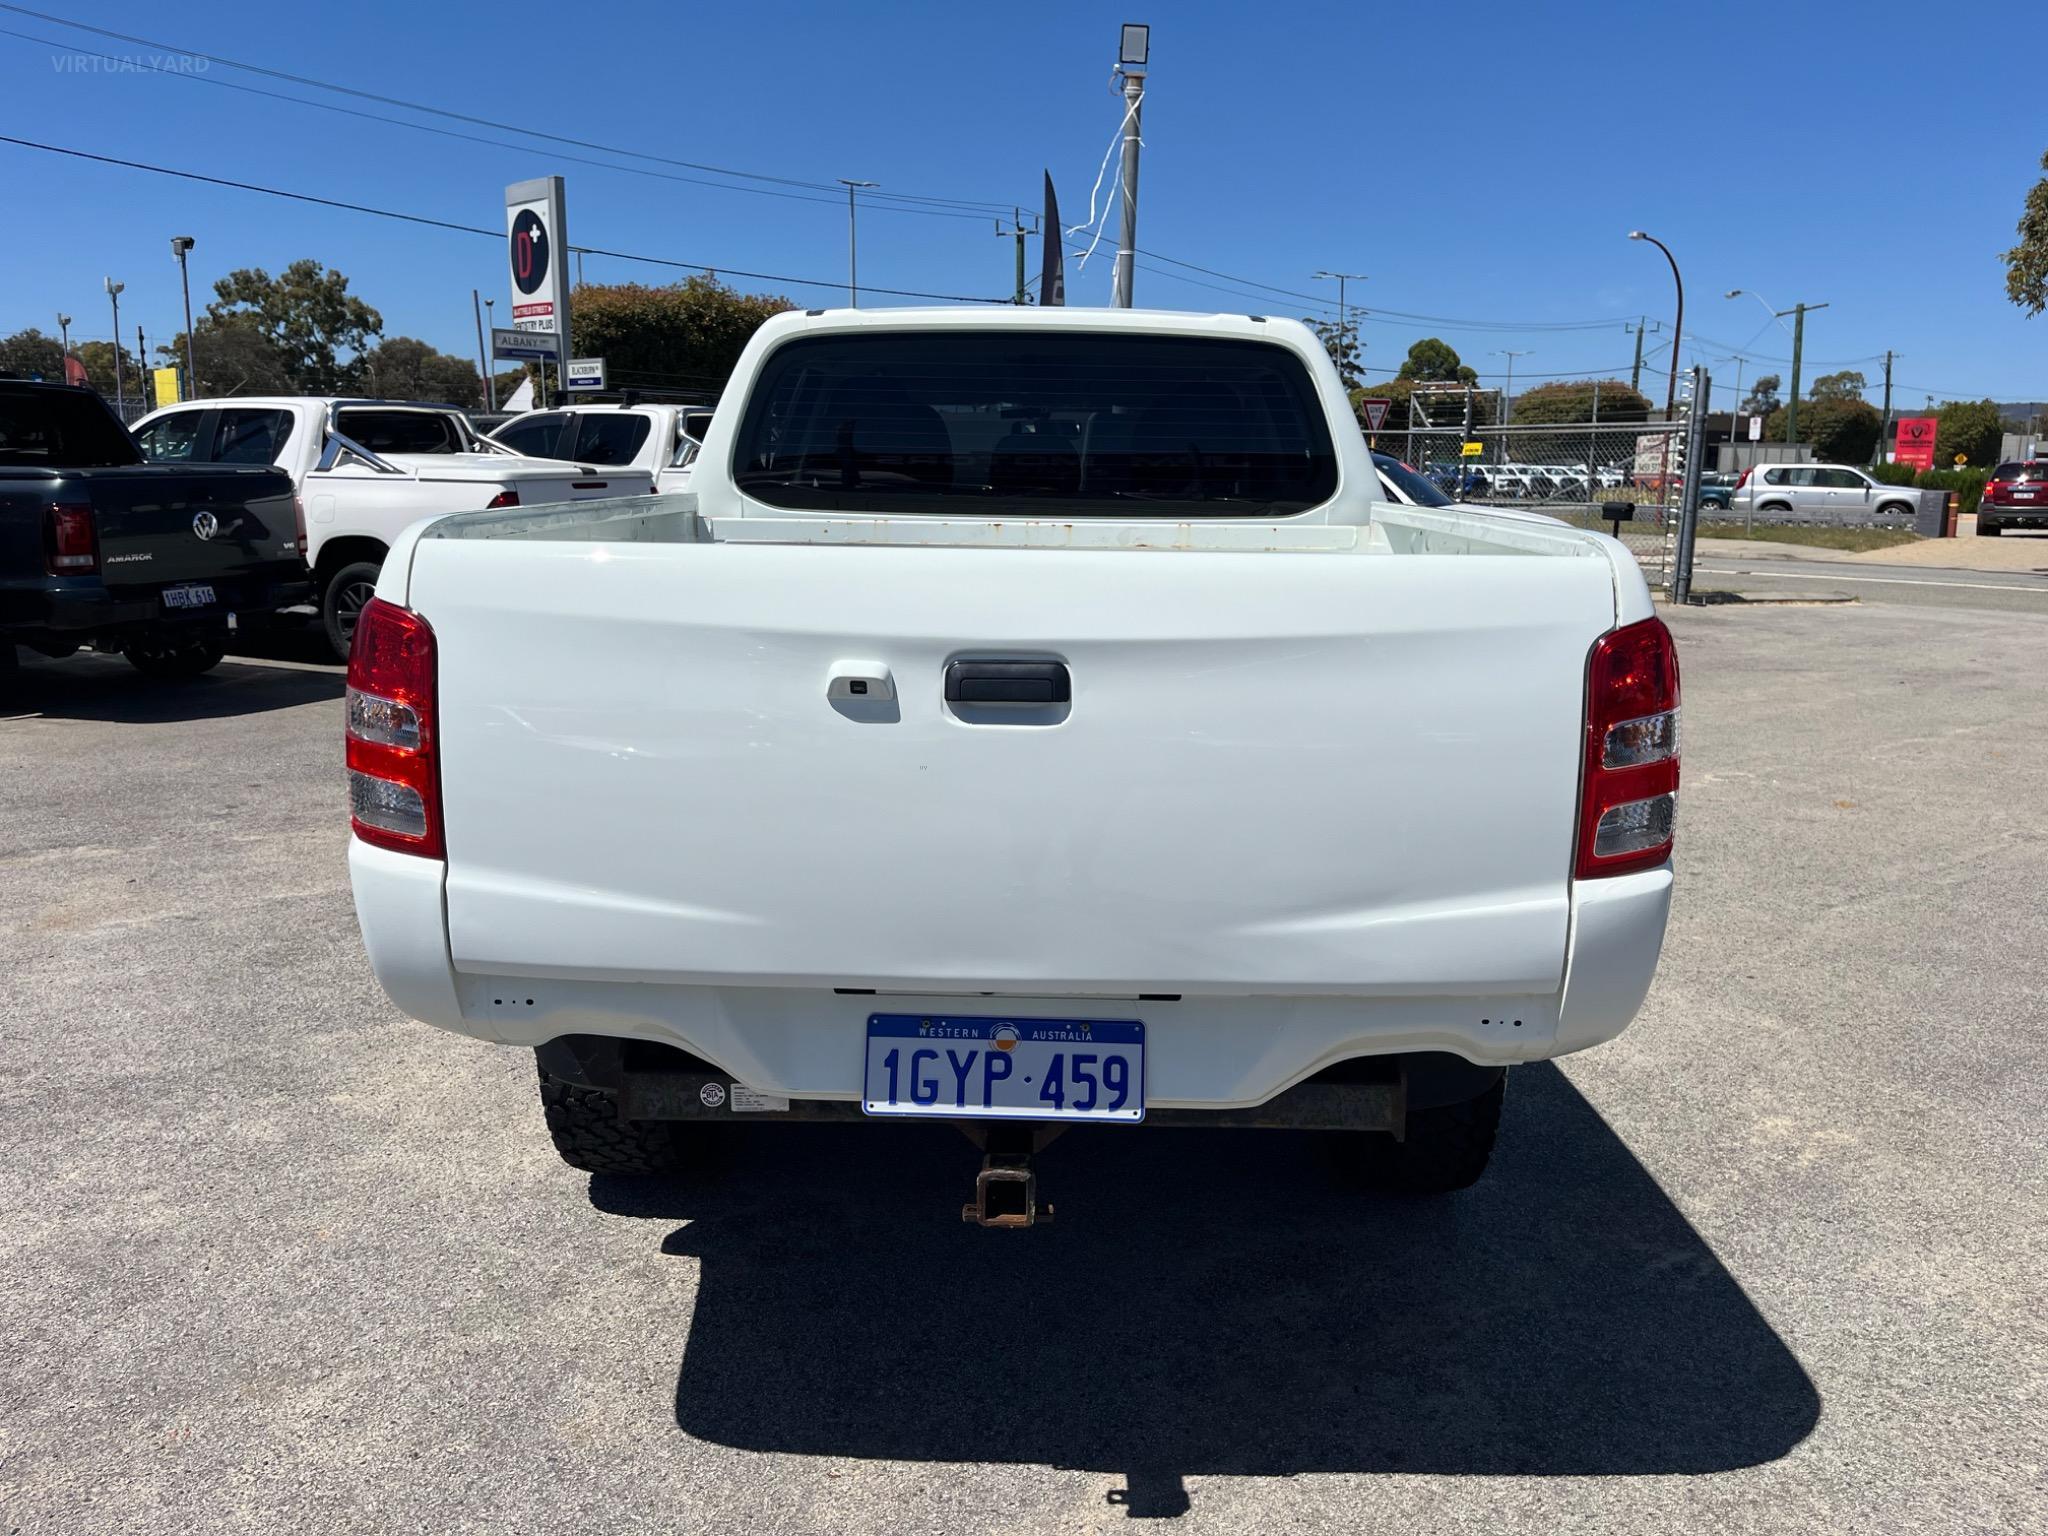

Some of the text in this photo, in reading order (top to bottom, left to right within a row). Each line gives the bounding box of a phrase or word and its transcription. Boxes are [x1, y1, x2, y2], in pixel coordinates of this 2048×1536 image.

[538, 319, 553, 330] PLUS
[501, 336, 538, 347] ALBANY
[1369, 406, 1383, 414] GIVE
[919, 1027, 1093, 1042] WESTERN AUSTRALIA
